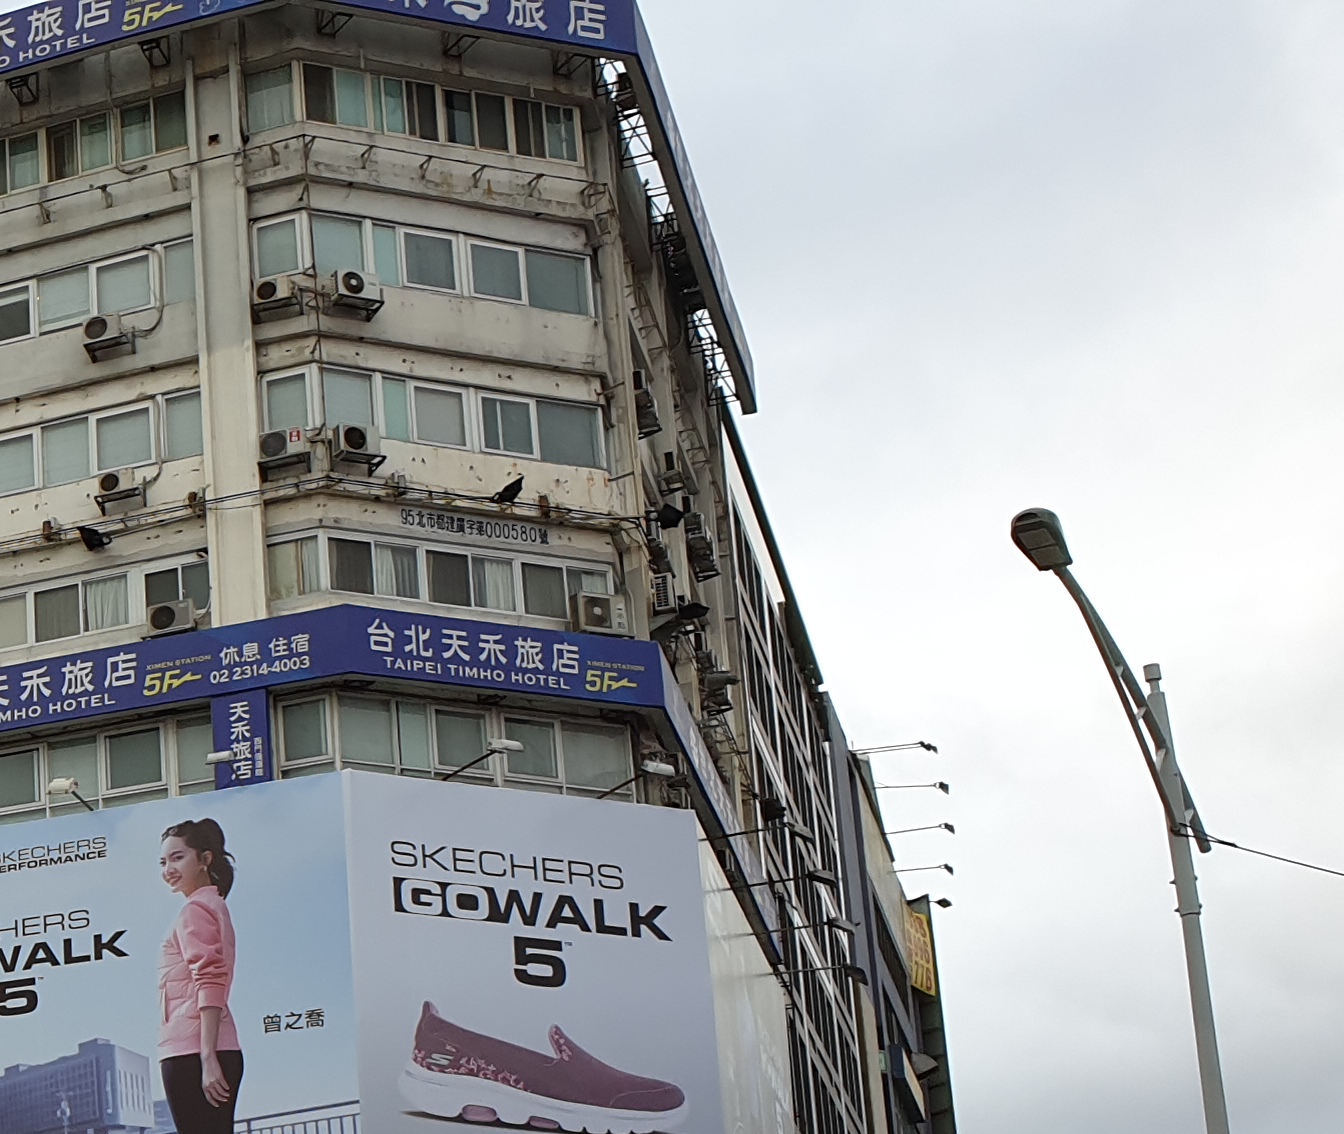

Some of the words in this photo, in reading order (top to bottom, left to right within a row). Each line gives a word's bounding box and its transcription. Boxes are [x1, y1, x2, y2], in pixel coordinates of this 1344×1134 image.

[18, 32, 96, 63] HOTEL
[220, 643, 261, 666] 休息
[269, 634, 310, 657] 住宿
[367, 618, 580, 674] 台北天禾旅店
[210, 671, 229, 684] 02
[232, 656, 310, 680] 2314-4003
[384, 656, 441, 675] TAIPEI
[447, 665, 504, 683] TIMHO
[511, 672, 570, 690] HOTEL
[48, 693, 115, 715] HOTEL
[229, 701, 253, 781] 天禾旅店
[390, 841, 624, 889] SKECHERS
[393, 876, 672, 941] GOWALK
[513, 935, 566, 988] 5
[263, 1008, 325, 1034] 曾之喬
